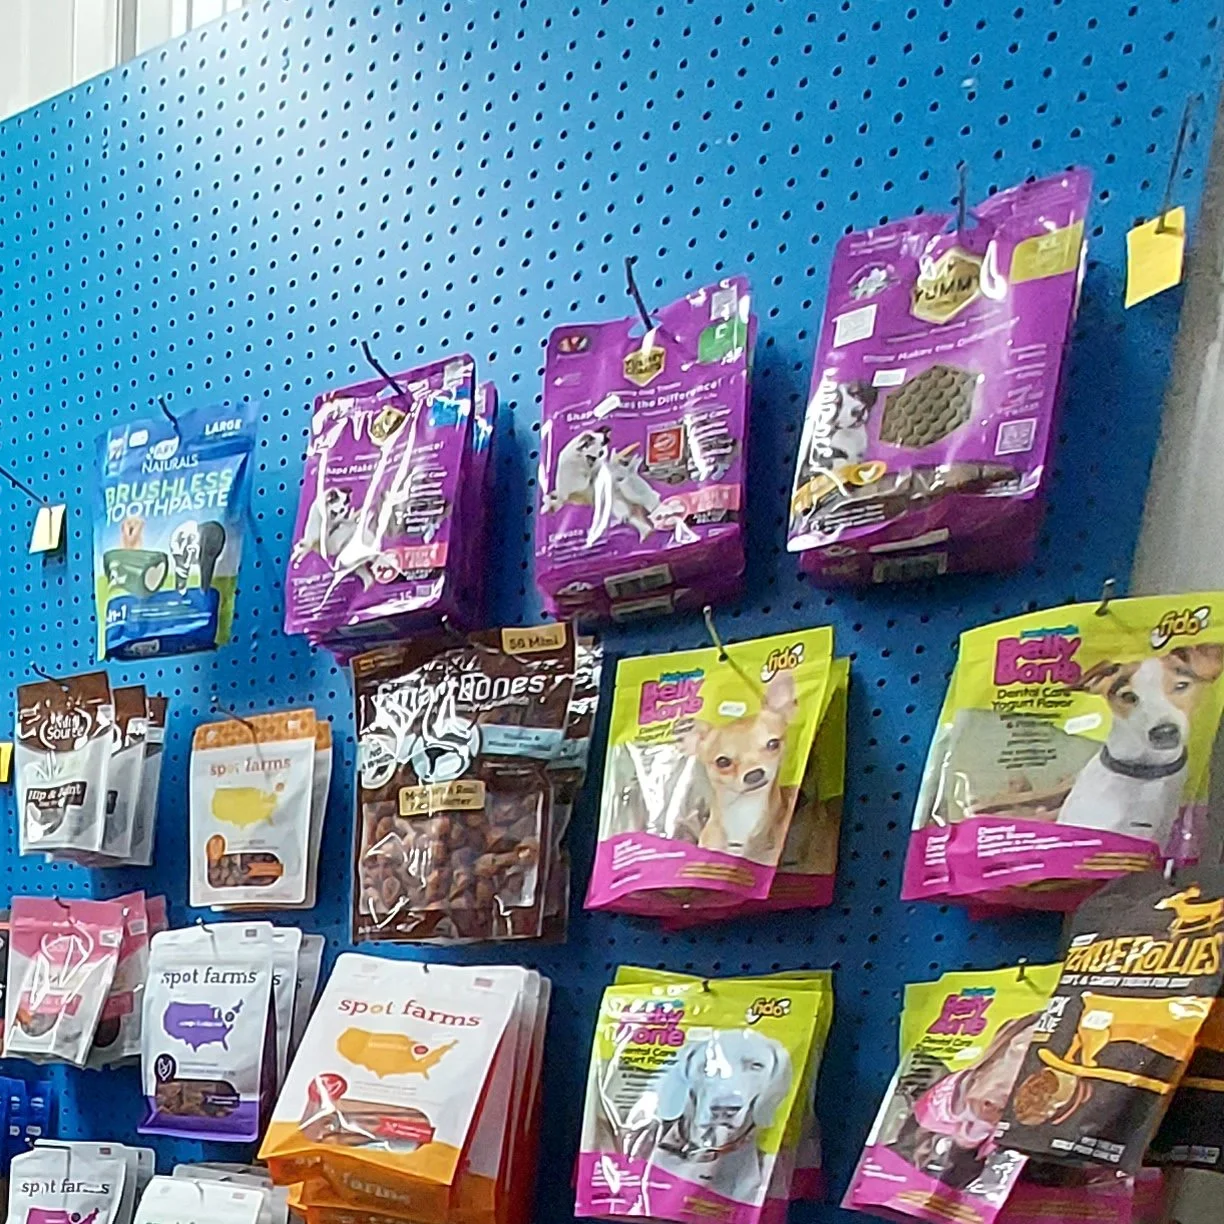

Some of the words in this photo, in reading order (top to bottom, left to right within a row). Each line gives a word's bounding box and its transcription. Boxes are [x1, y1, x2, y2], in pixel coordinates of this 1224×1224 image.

[205, 418, 242, 436] LARGE
[141, 454, 198, 474] NATURALS
[106, 469, 234, 504] BRUSHLESS
[106, 490, 229, 526] TOOTHPASTE
[995, 635, 1081, 661] Belly
[994, 661, 1081, 686] Bone
[378, 672, 545, 707] SmartBones
[997, 688, 1039, 701] Dental
[1043, 687, 1072, 699] Care
[638, 697, 704, 725] Bone
[992, 700, 1035, 714] Yogurt
[1038, 697, 1073, 709] Flavor
[47, 726, 85, 741] Source
[245, 756, 291, 774] farms
[28, 789, 46, 801] Hip
[161, 970, 199, 987] spot
[203, 966, 257, 985] farms
[337, 998, 393, 1015] spot
[402, 999, 480, 1028] farms
[752, 998, 783, 1018] fido
